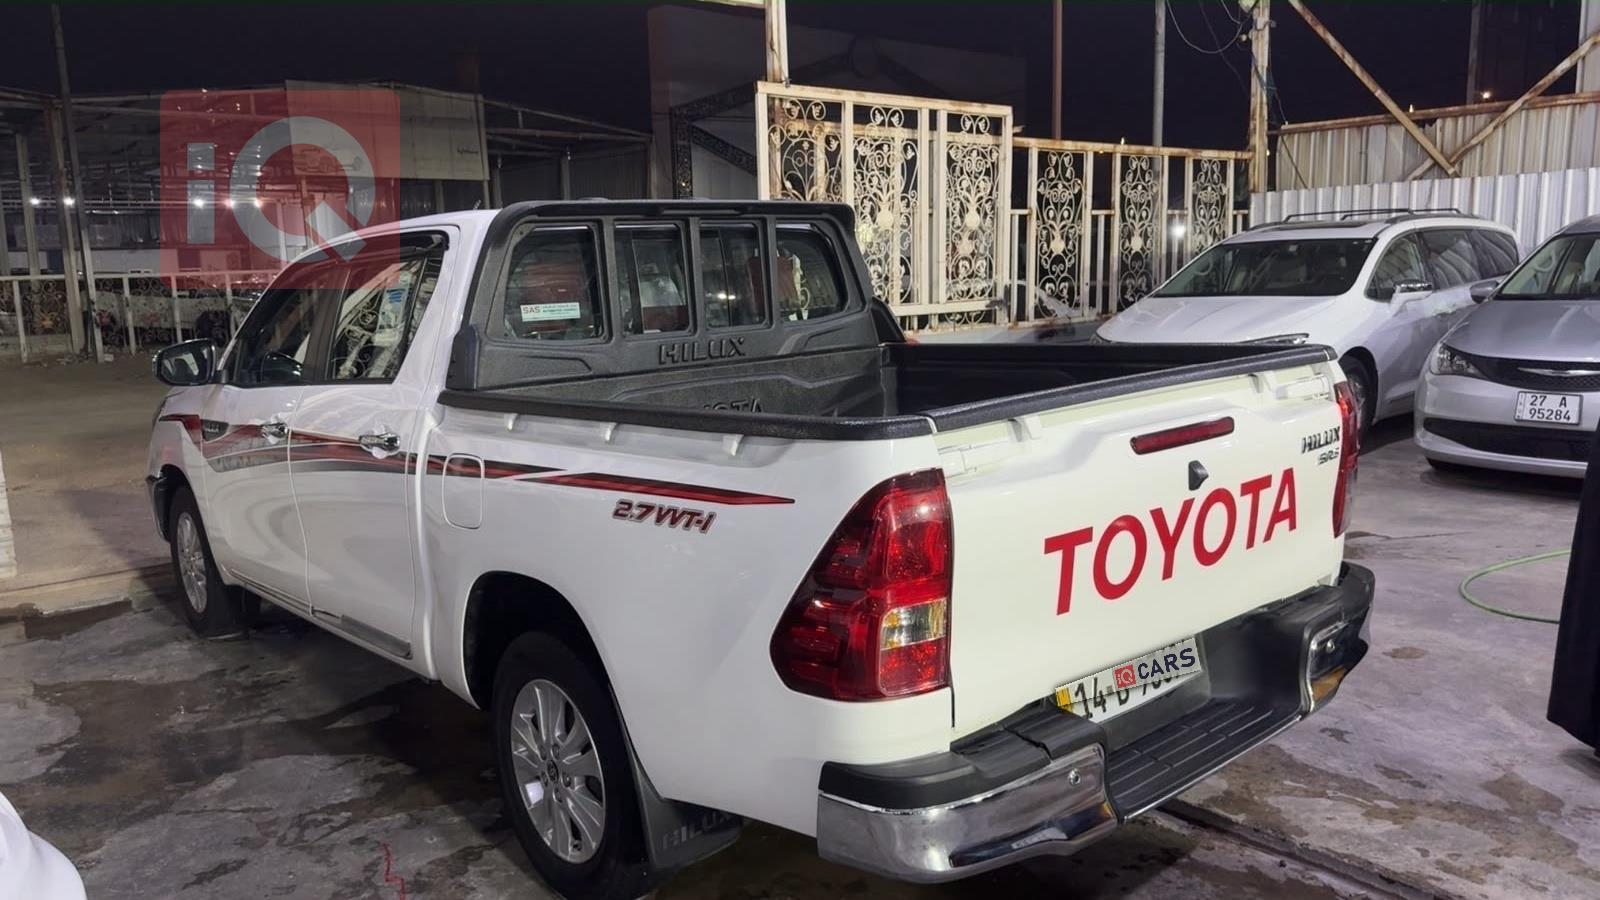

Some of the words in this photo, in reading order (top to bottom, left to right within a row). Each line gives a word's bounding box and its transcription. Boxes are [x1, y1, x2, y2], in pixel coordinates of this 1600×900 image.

[522, 306, 541, 316] SAS
[658, 337, 746, 365] HILUX
[1529, 407, 1571, 421] 95284
[1530, 394, 1547, 407] 27
[1559, 396, 1567, 408] A
[1301, 425, 1340, 455] HILUX
[1043, 467, 1297, 616] TOYOTA
[1074, 676, 1107, 720] 14
